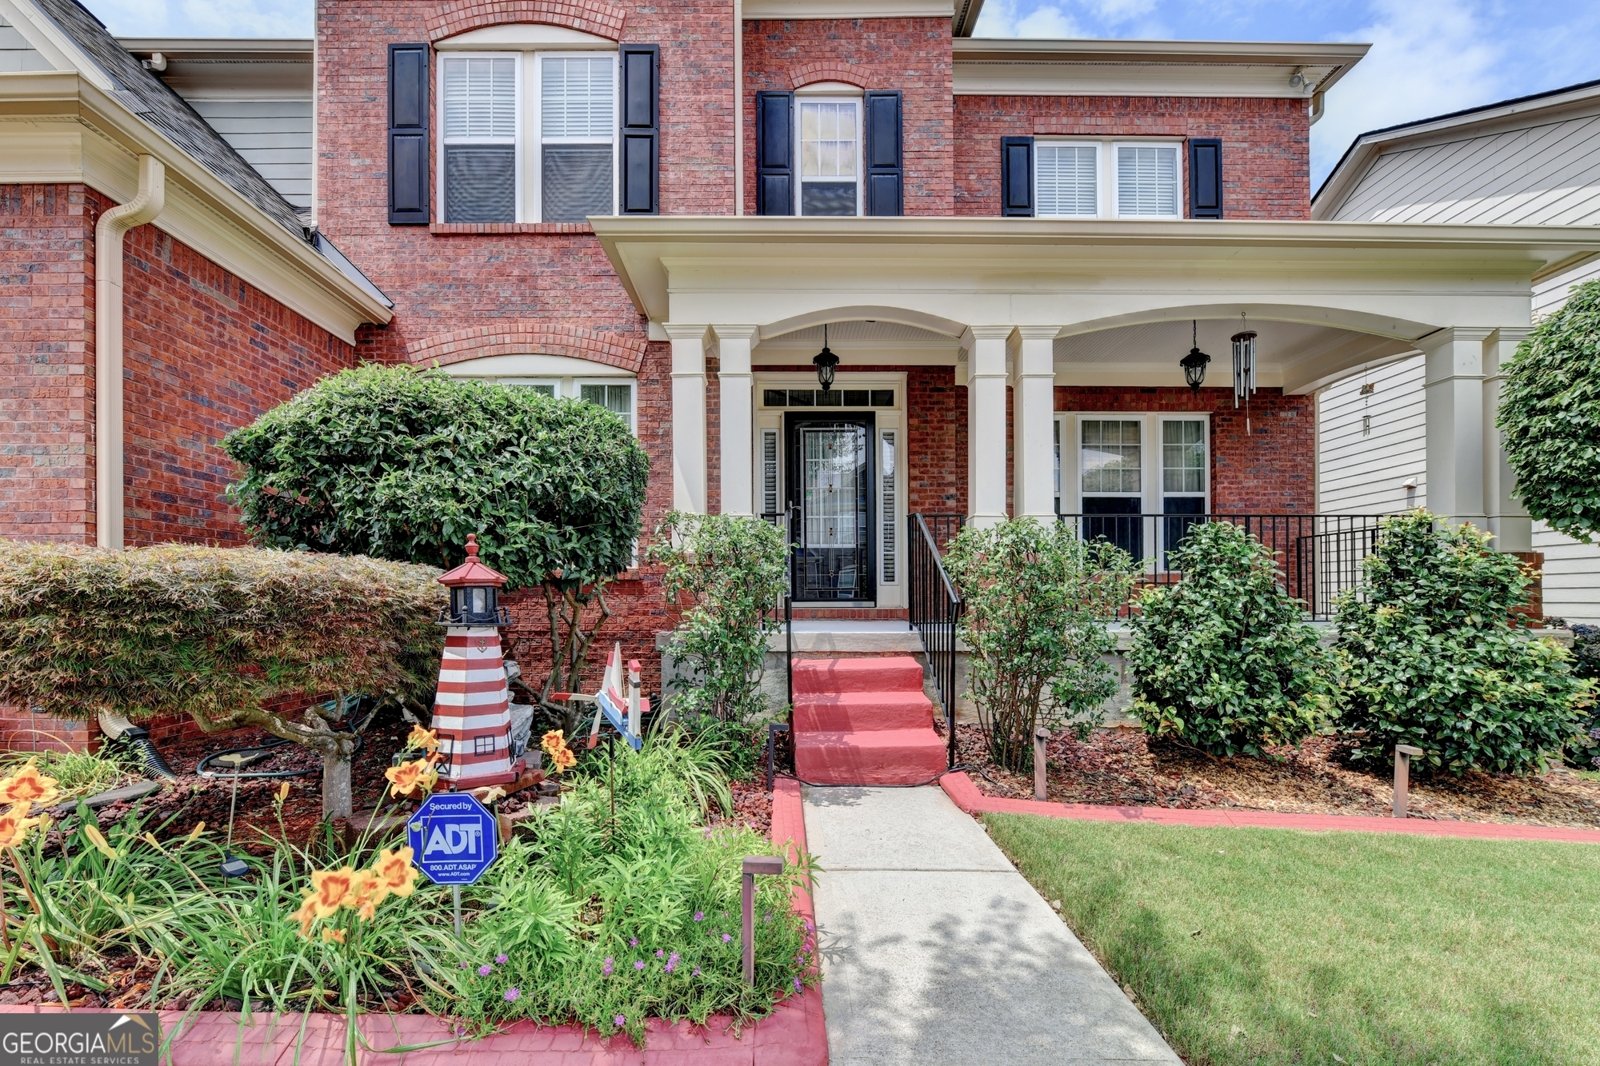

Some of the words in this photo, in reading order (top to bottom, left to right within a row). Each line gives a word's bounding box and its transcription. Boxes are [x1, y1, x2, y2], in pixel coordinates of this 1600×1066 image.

[429, 802, 462, 810] Secured
[462, 802, 473, 811] by
[423, 823, 482, 855] ADT
